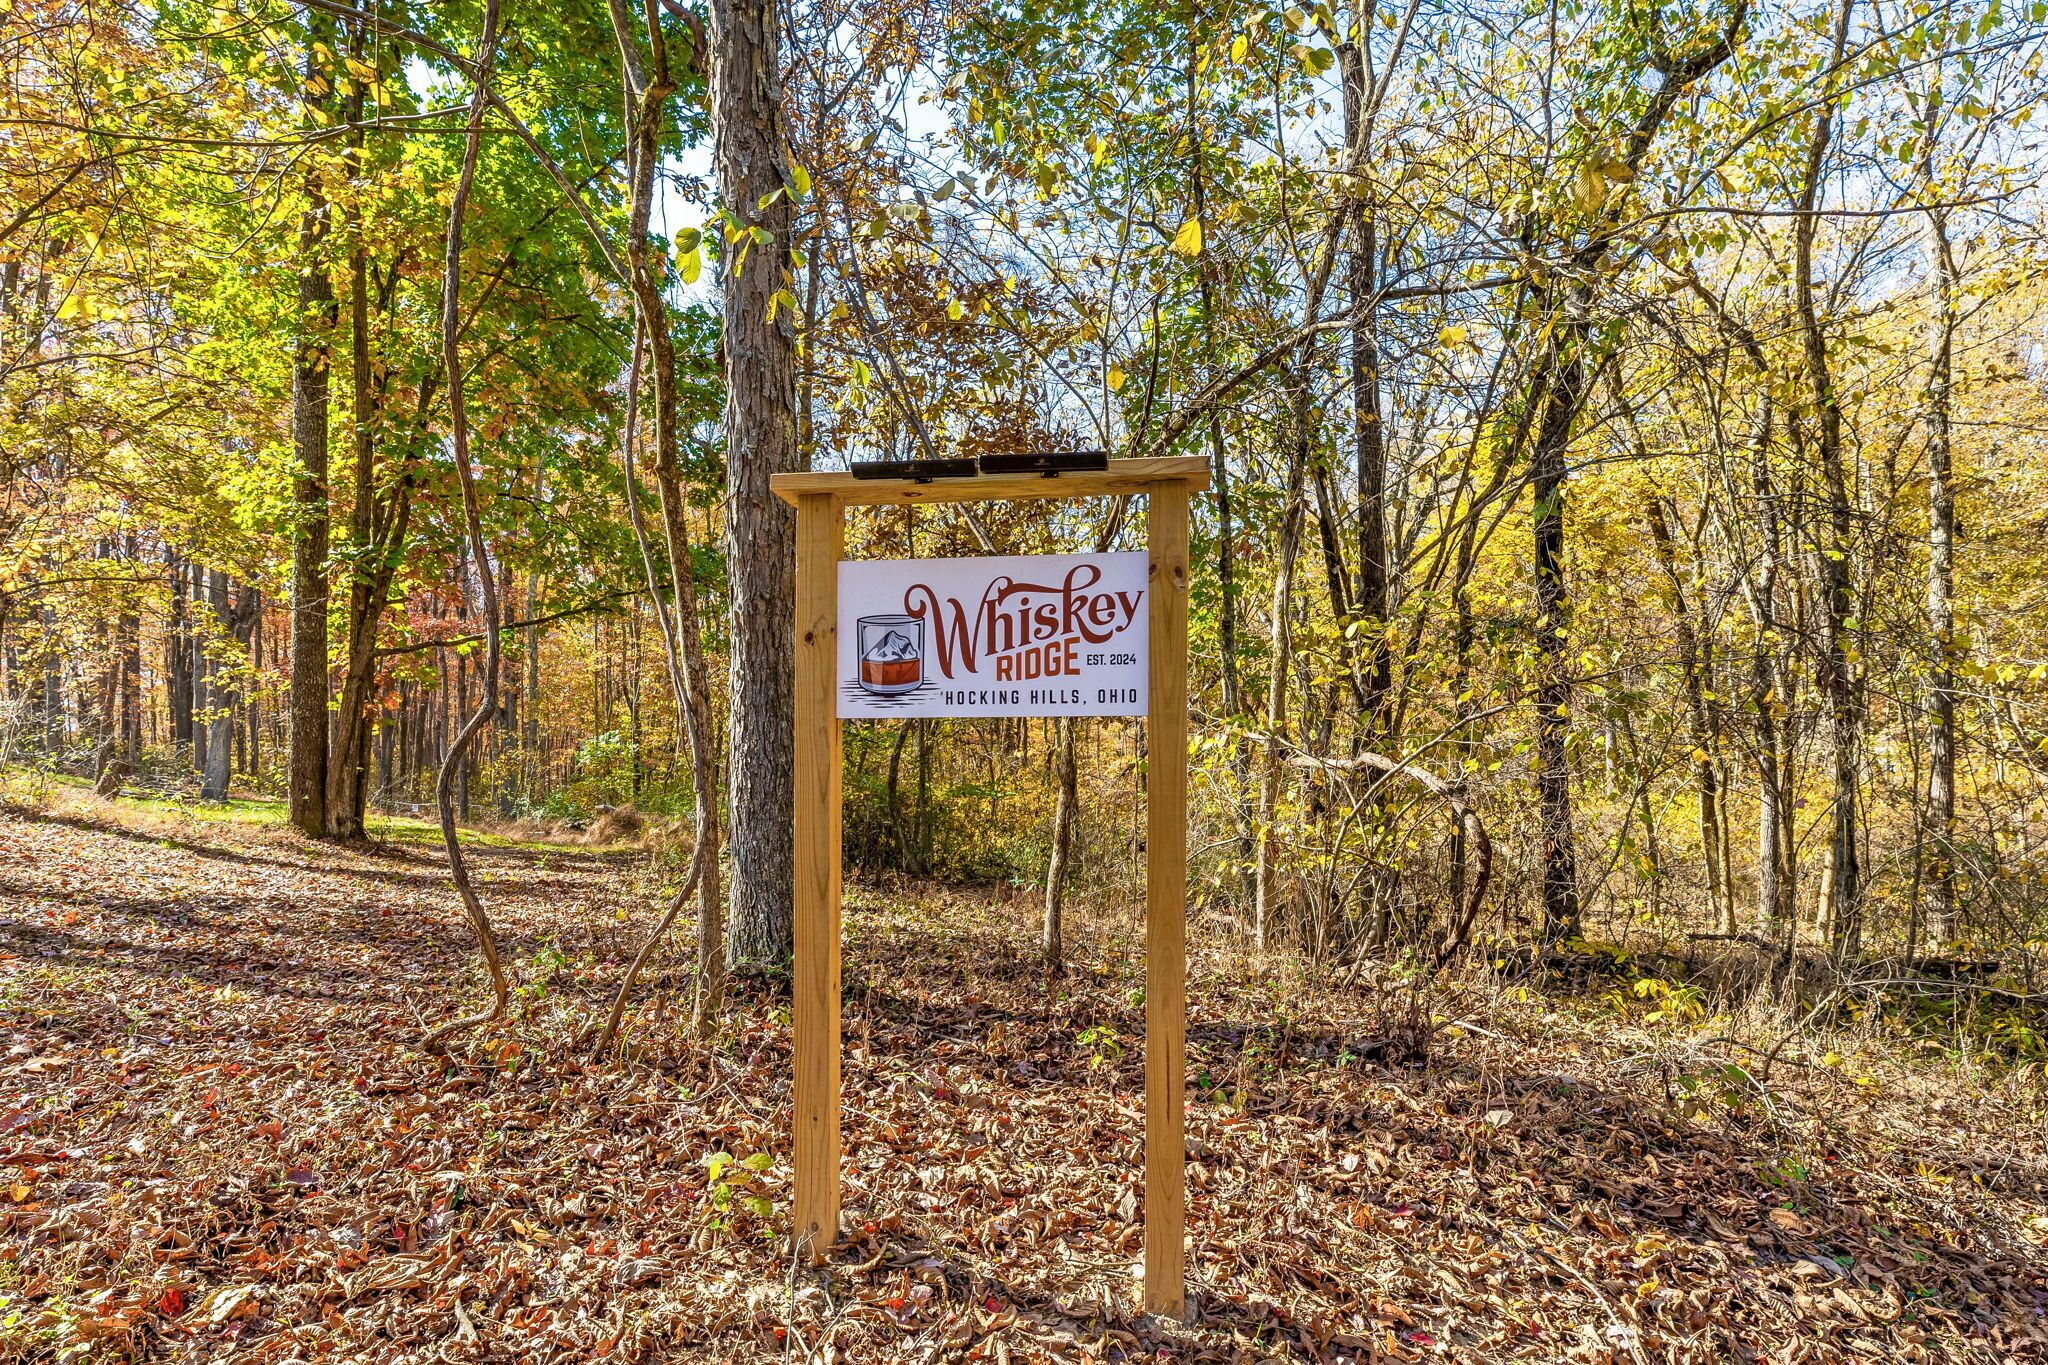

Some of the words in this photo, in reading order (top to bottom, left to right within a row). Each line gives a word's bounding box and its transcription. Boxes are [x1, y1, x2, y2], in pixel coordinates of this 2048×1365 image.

[904, 564, 1145, 679] Whiskey
[996, 636, 1081, 681] RIDGE
[1086, 654, 1107, 666] EST.
[1109, 653, 1137, 665] 2024
[945, 690, 1019, 704] HOCKING
[1030, 689, 1087, 705] HILLS,
[1097, 688, 1137, 703] OHIO
